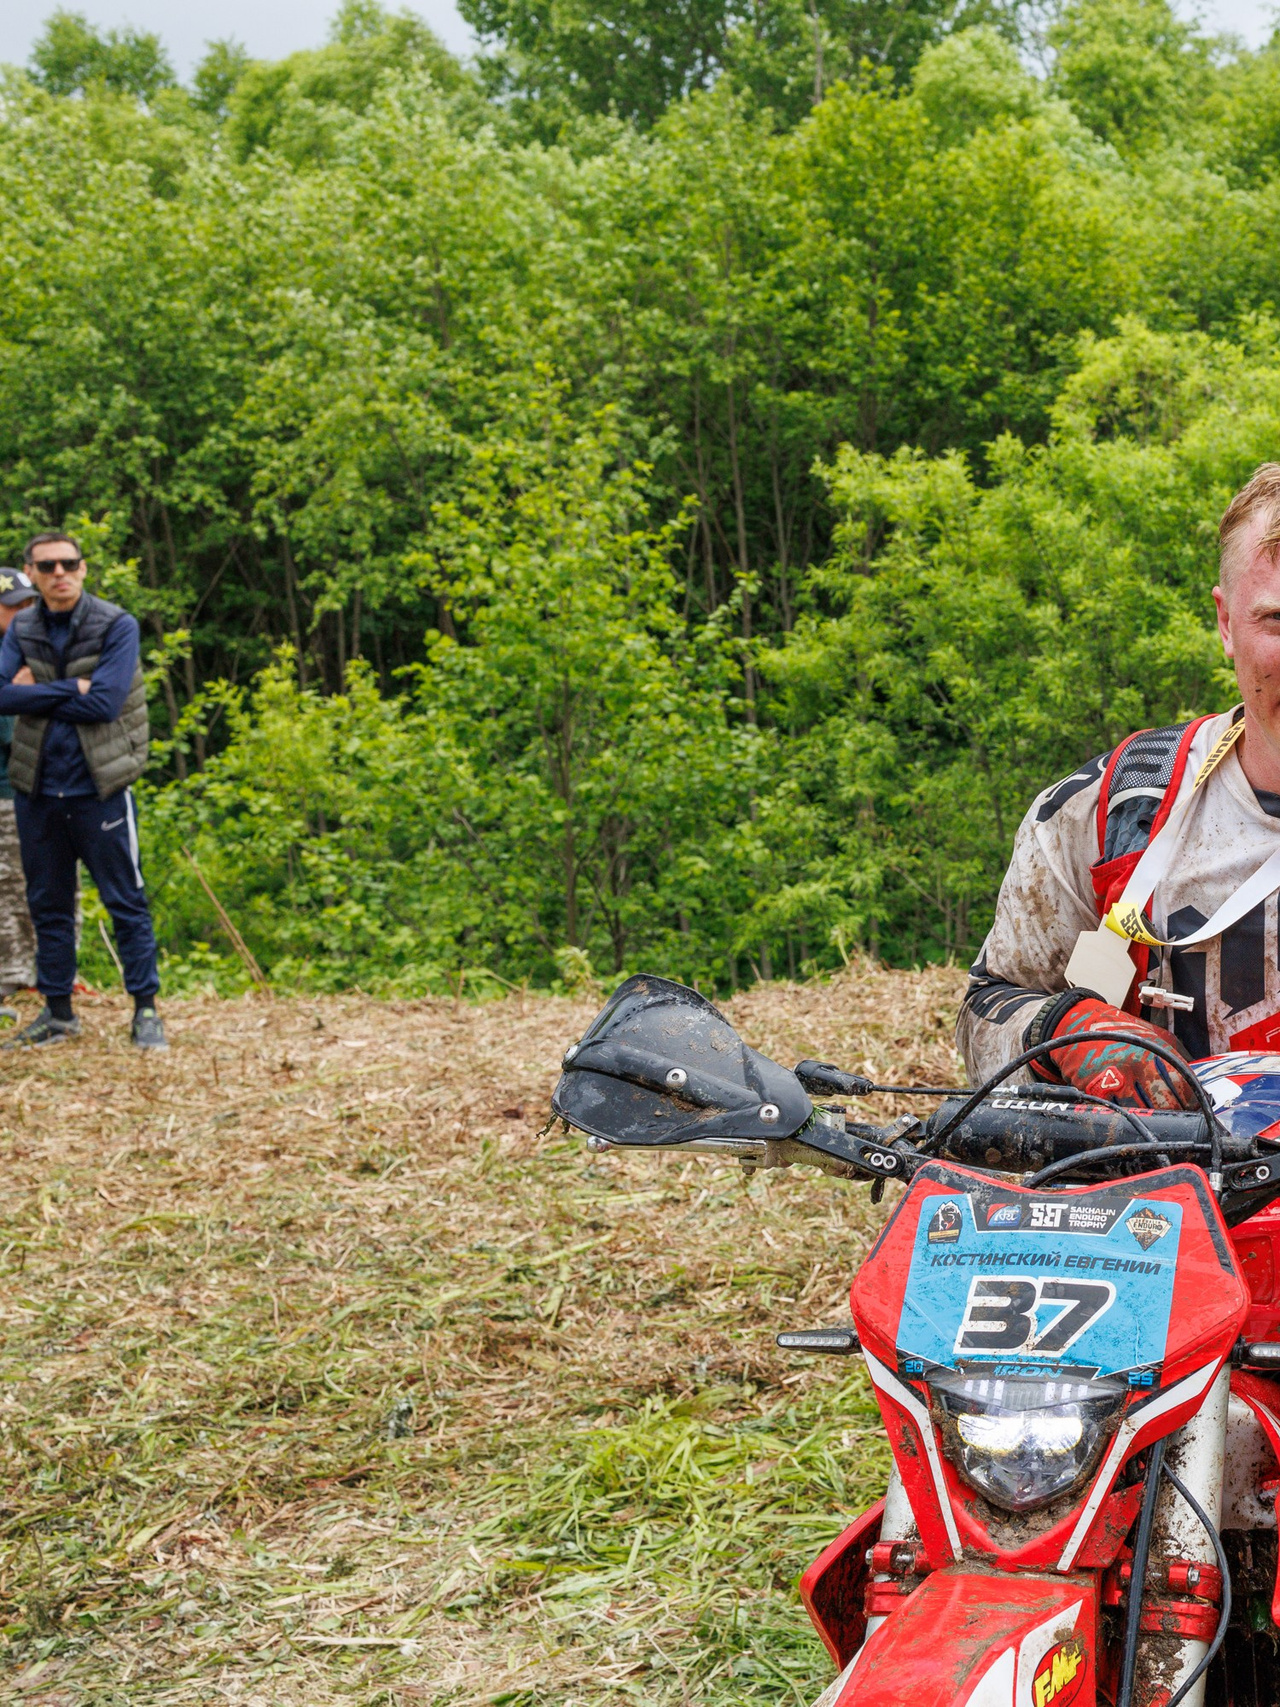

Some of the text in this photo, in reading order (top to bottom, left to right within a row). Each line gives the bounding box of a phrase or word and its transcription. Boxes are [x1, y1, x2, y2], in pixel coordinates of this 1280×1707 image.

[1069, 1206, 1116, 1217] SAKHALIN
[1069, 1213, 1108, 1222] ENDURO
[1068, 1220, 1107, 1229] TROPHY
[930, 1251, 1062, 1267] КОСТИНСКИЙ
[953, 1275, 1117, 1358] 37
[905, 1360, 924, 1373] 20
[1128, 1372, 1154, 1386] 25
[1034, 1643, 1082, 1707] FMF
